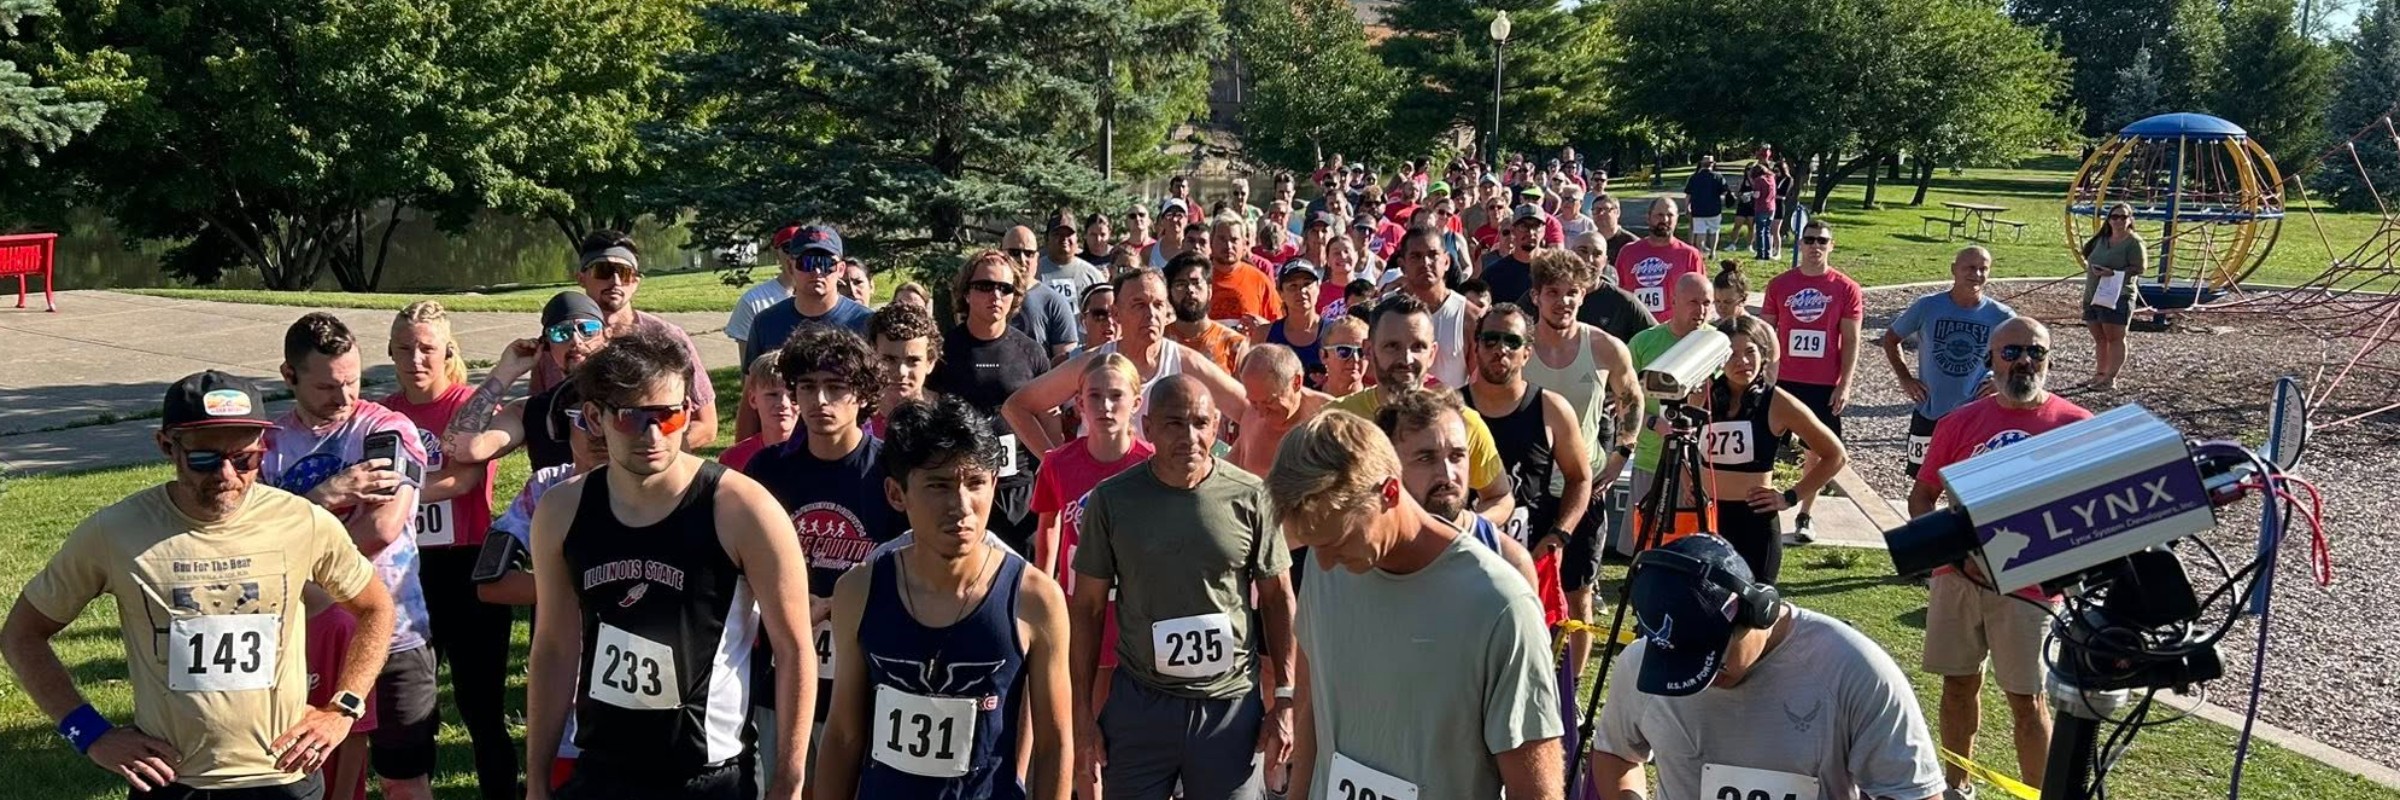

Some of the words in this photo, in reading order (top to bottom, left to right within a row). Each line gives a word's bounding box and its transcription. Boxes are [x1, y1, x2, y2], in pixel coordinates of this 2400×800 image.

[1050, 283, 1072, 297] 26
[1794, 335, 1820, 351] 219
[1936, 320, 1989, 343] HARLEY
[1934, 352, 1980, 373] DAVIDSON
[1706, 430, 1745, 456] 273
[415, 503, 442, 533] 60
[2042, 475, 2174, 540] LYNX
[2070, 533, 2092, 546] Lynx
[2092, 522, 2125, 538] System
[173, 561, 192, 573] Run
[193, 561, 209, 573] For
[211, 560, 229, 572] The
[229, 558, 252, 570] Bear
[584, 559, 642, 591] ILLINOIS
[645, 559, 685, 591] STATE
[187, 631, 262, 675] 143
[816, 630, 832, 664] 4
[1166, 628, 1223, 667] 235
[602, 644, 662, 696] 233
[1667, 681, 1681, 690] U.S.
[1682, 678, 1697, 689] AIR
[1696, 656, 1715, 681] FORCE
[887, 708, 954, 760] 131
